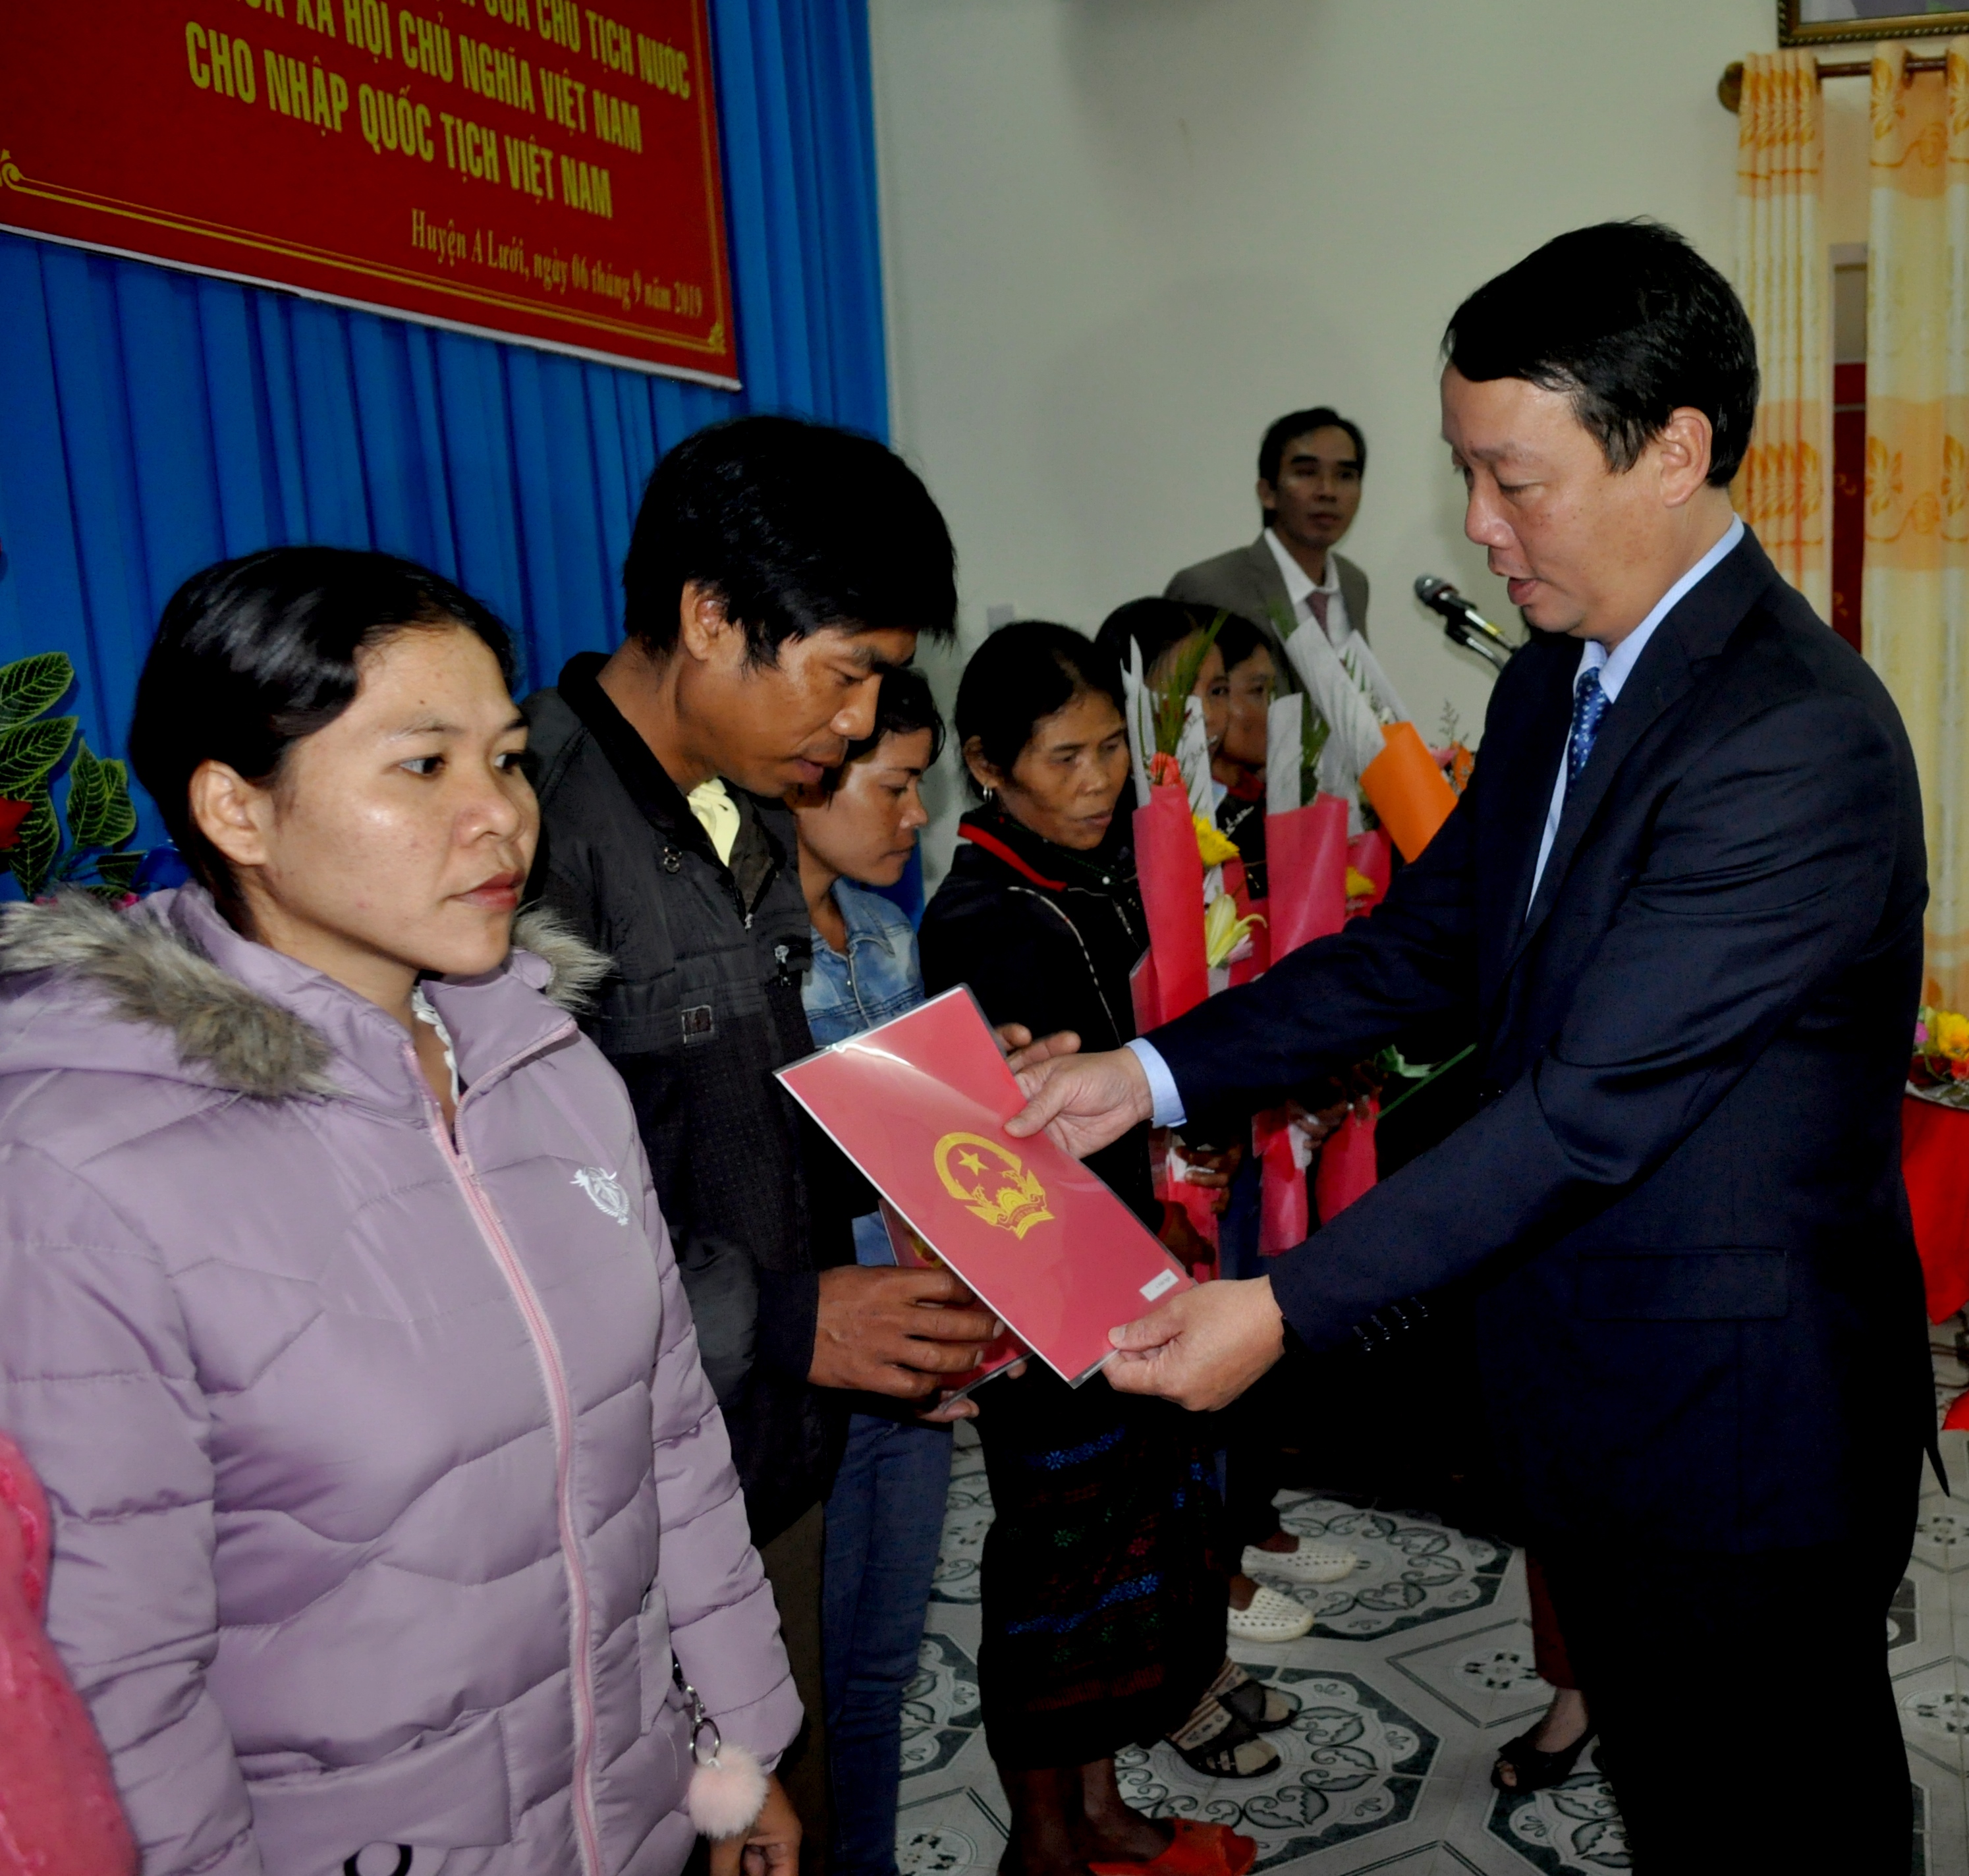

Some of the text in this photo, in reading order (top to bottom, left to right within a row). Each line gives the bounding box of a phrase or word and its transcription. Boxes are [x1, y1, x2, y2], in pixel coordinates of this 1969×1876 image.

[399, 10, 454, 83] CHỦ
[459, 35, 536, 114] NGHĨA
[539, 67, 587, 137] VIỆT
[593, 90, 643, 154] NAM
[585, 9, 634, 76] TỊCH
[185, 21, 613, 219] CHO NHẬP QUỐC TỊCH VIỆT NAM
[411, 207, 703, 318] Huyện A Lưới, ngày 06 tháng 9 năm 2019
